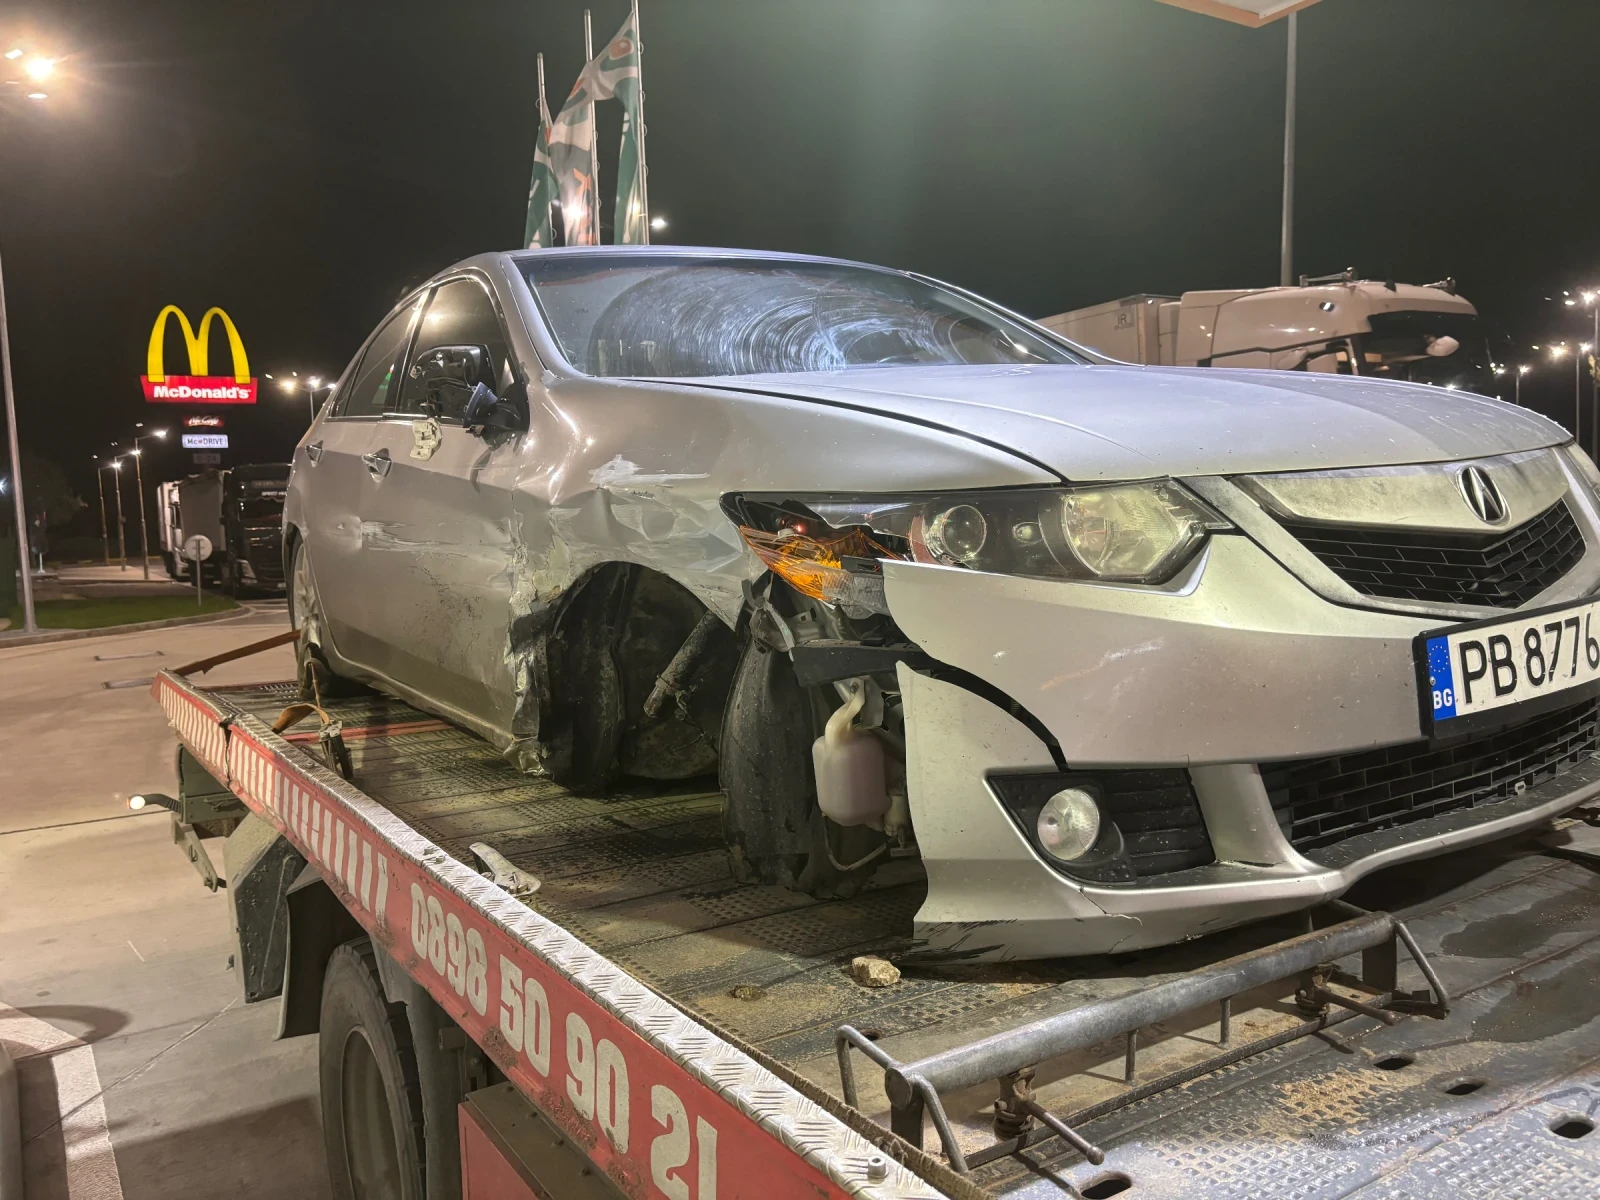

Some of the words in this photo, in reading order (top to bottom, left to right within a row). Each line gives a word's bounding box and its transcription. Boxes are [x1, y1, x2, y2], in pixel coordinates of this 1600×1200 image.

[153, 385, 250, 399] McDonald's
[1459, 634, 1518, 704] PB
[1523, 612, 1600, 687] 8776
[1432, 688, 1453, 710] BG
[411, 882, 488, 1017] 0898
[500, 953, 551, 1078] 50
[566, 1012, 630, 1154] 90
[651, 1084, 718, 1200] 21
